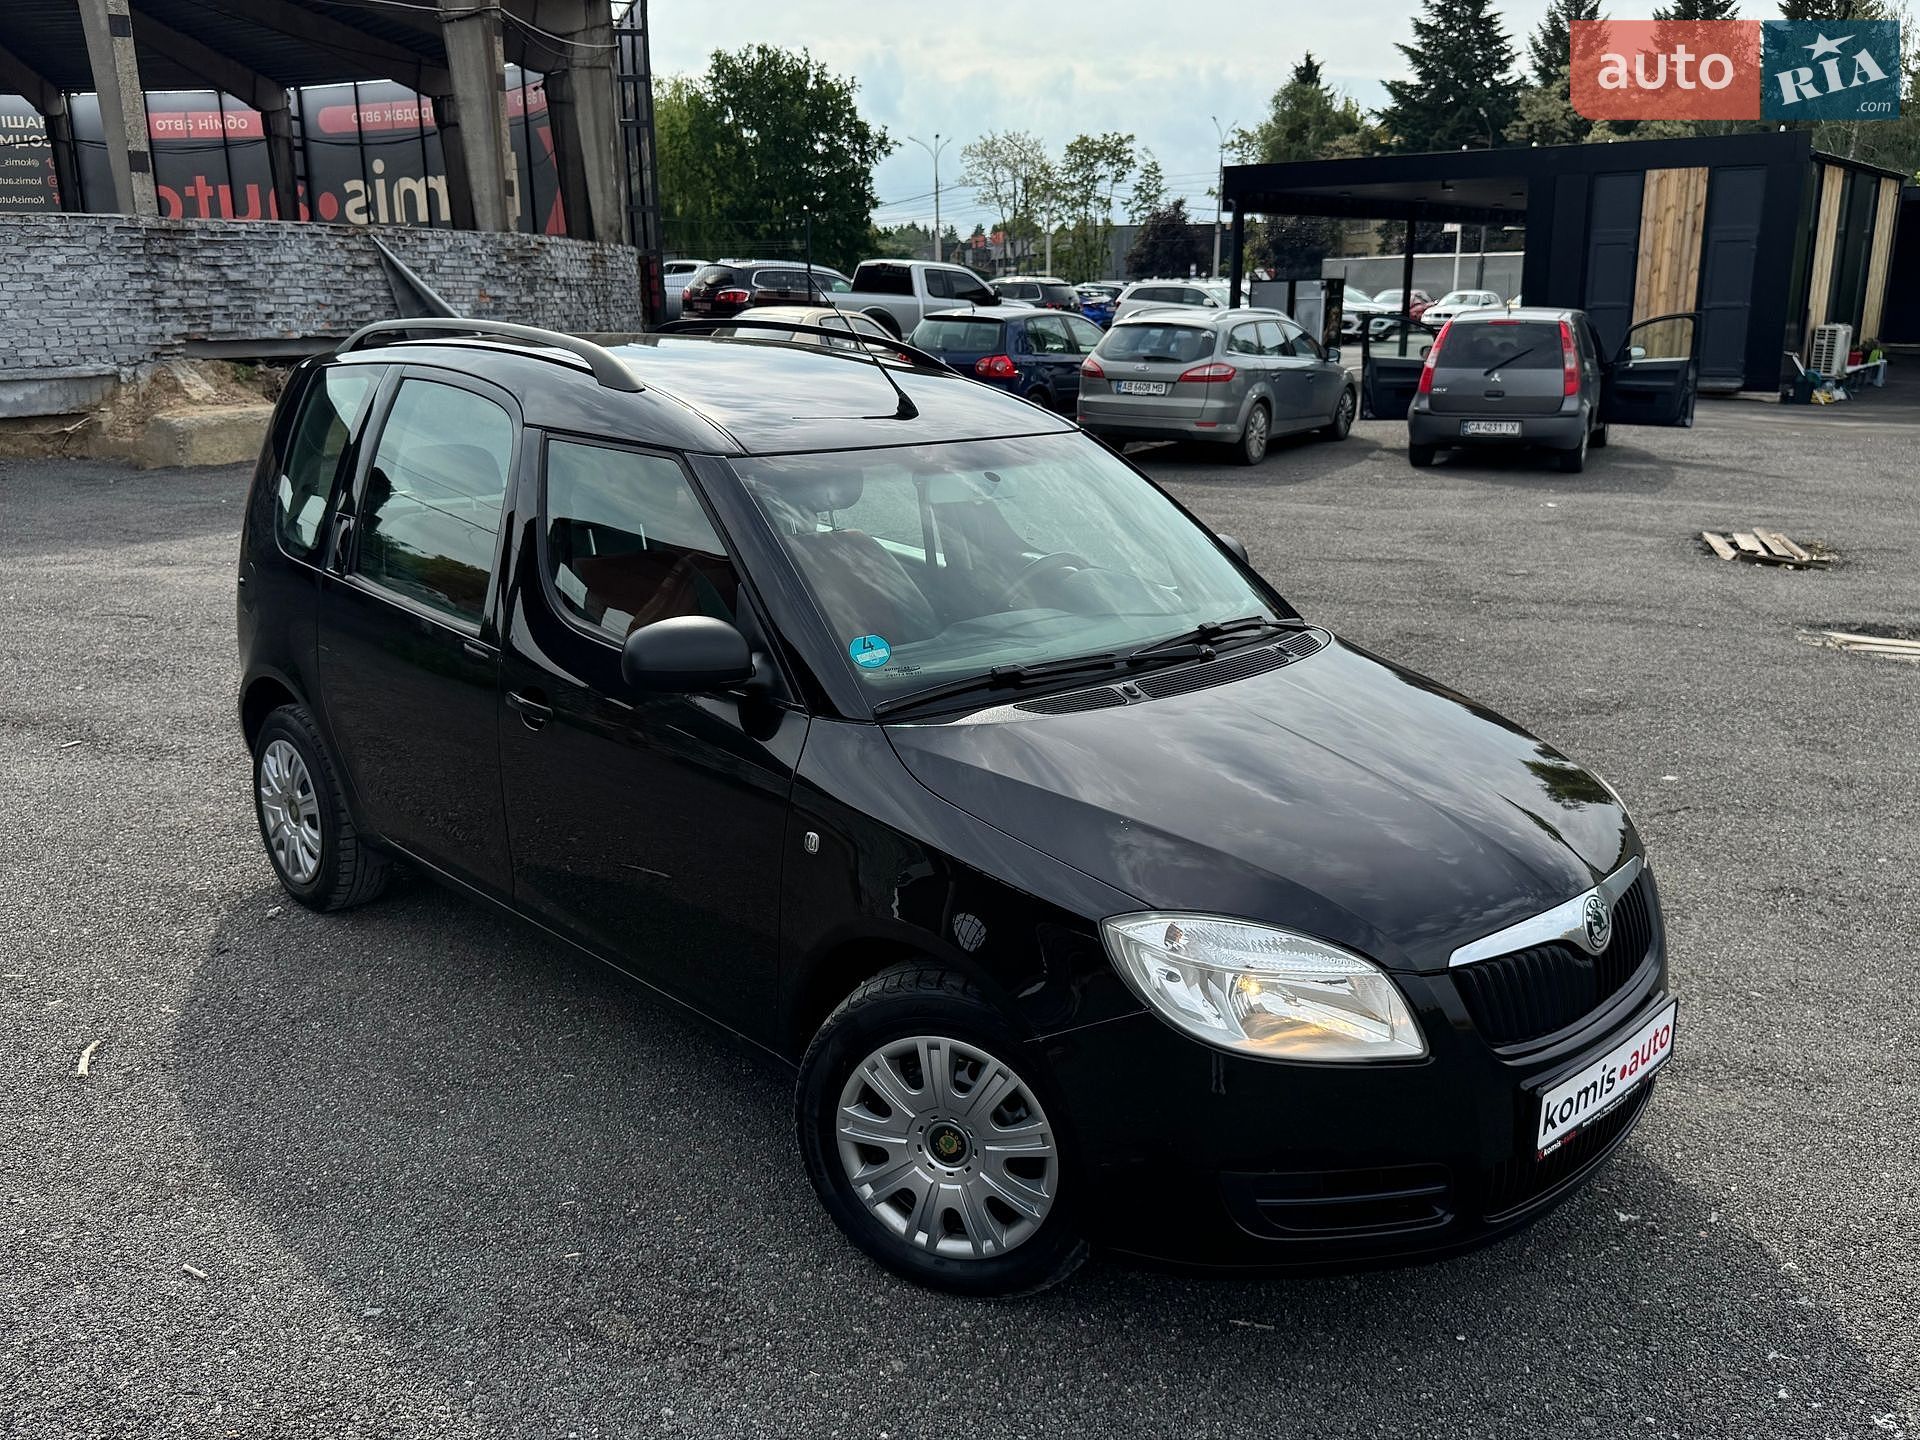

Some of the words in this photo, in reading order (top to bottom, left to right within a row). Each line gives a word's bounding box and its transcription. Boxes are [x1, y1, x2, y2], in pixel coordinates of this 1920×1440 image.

[862, 636, 874, 650] 4
[1542, 1063, 1617, 1137] komis
[1628, 1024, 1670, 1077] auto
